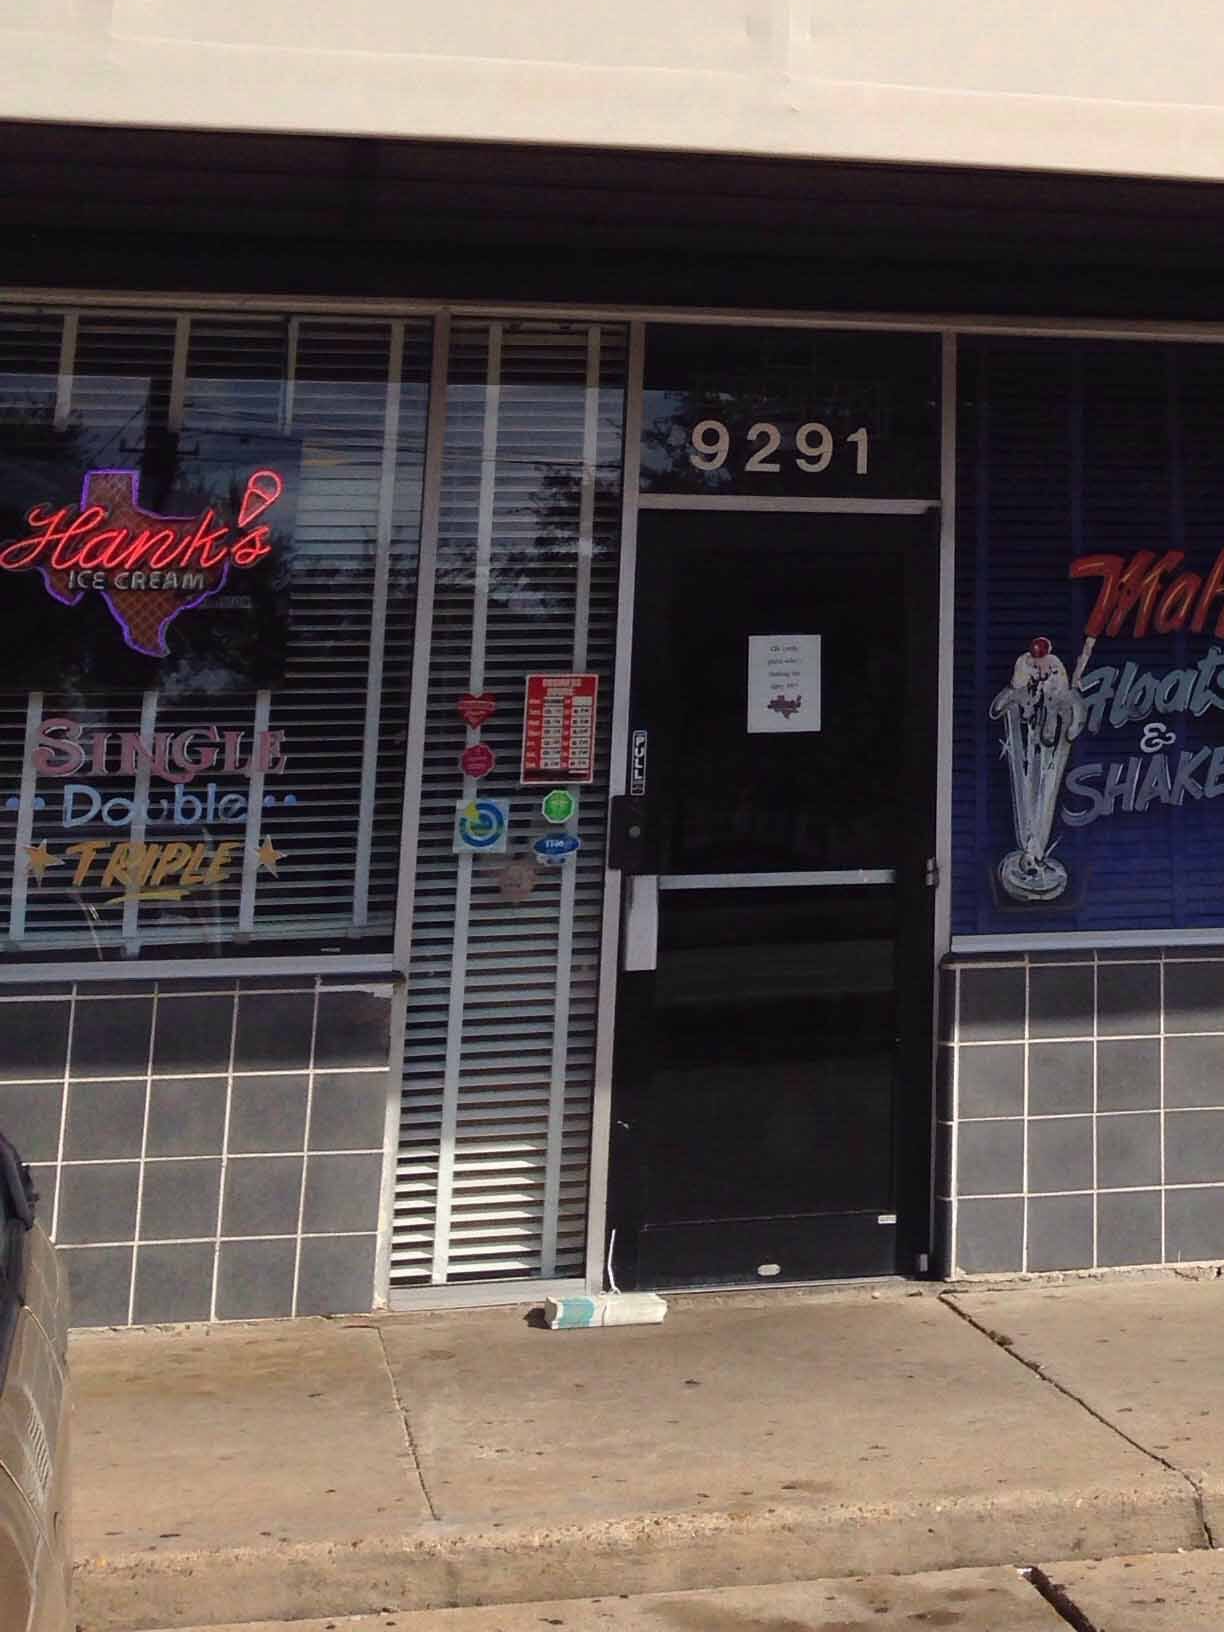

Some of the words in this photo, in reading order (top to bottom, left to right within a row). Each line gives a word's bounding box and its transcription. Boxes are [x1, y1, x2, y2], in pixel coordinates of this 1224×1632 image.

[690, 419, 870, 474] 9291
[0, 469, 283, 569] Hank's
[67, 571, 105, 590] ICE
[114, 571, 206, 590] CREAM
[32, 718, 288, 784] SINGLE
[634, 735, 645, 780] PULL
[1140, 723, 1177, 753] &
[66, 840, 242, 889] TRIPLE
